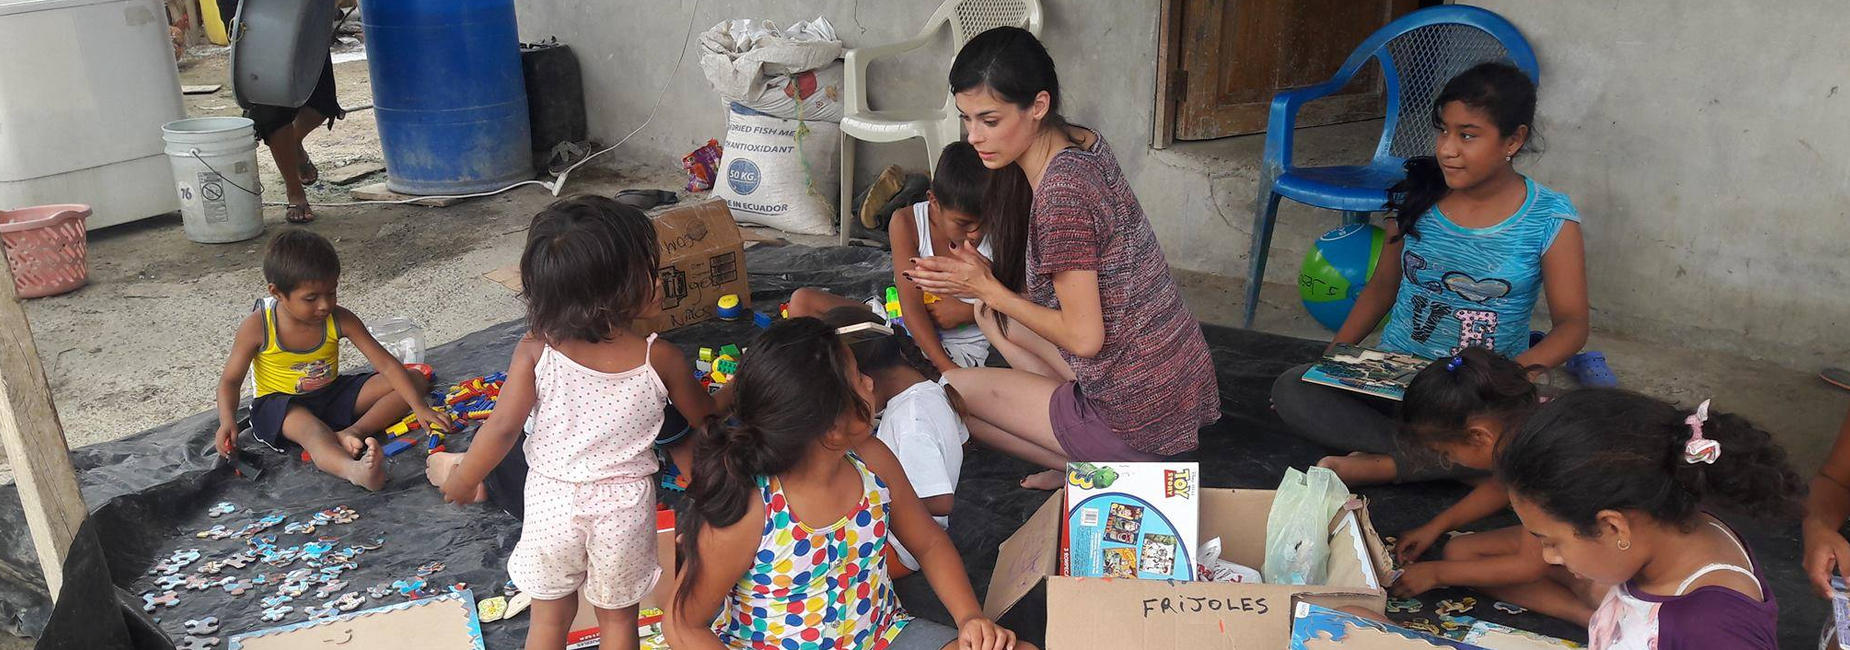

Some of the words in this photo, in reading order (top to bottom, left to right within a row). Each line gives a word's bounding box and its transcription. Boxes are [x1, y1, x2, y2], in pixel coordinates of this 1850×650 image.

[753, 126, 777, 135] FISH
[778, 129, 797, 137] ME
[730, 170, 740, 179] 50
[742, 203, 788, 212] ECUADOR
[1174, 468, 1191, 500] TOY
